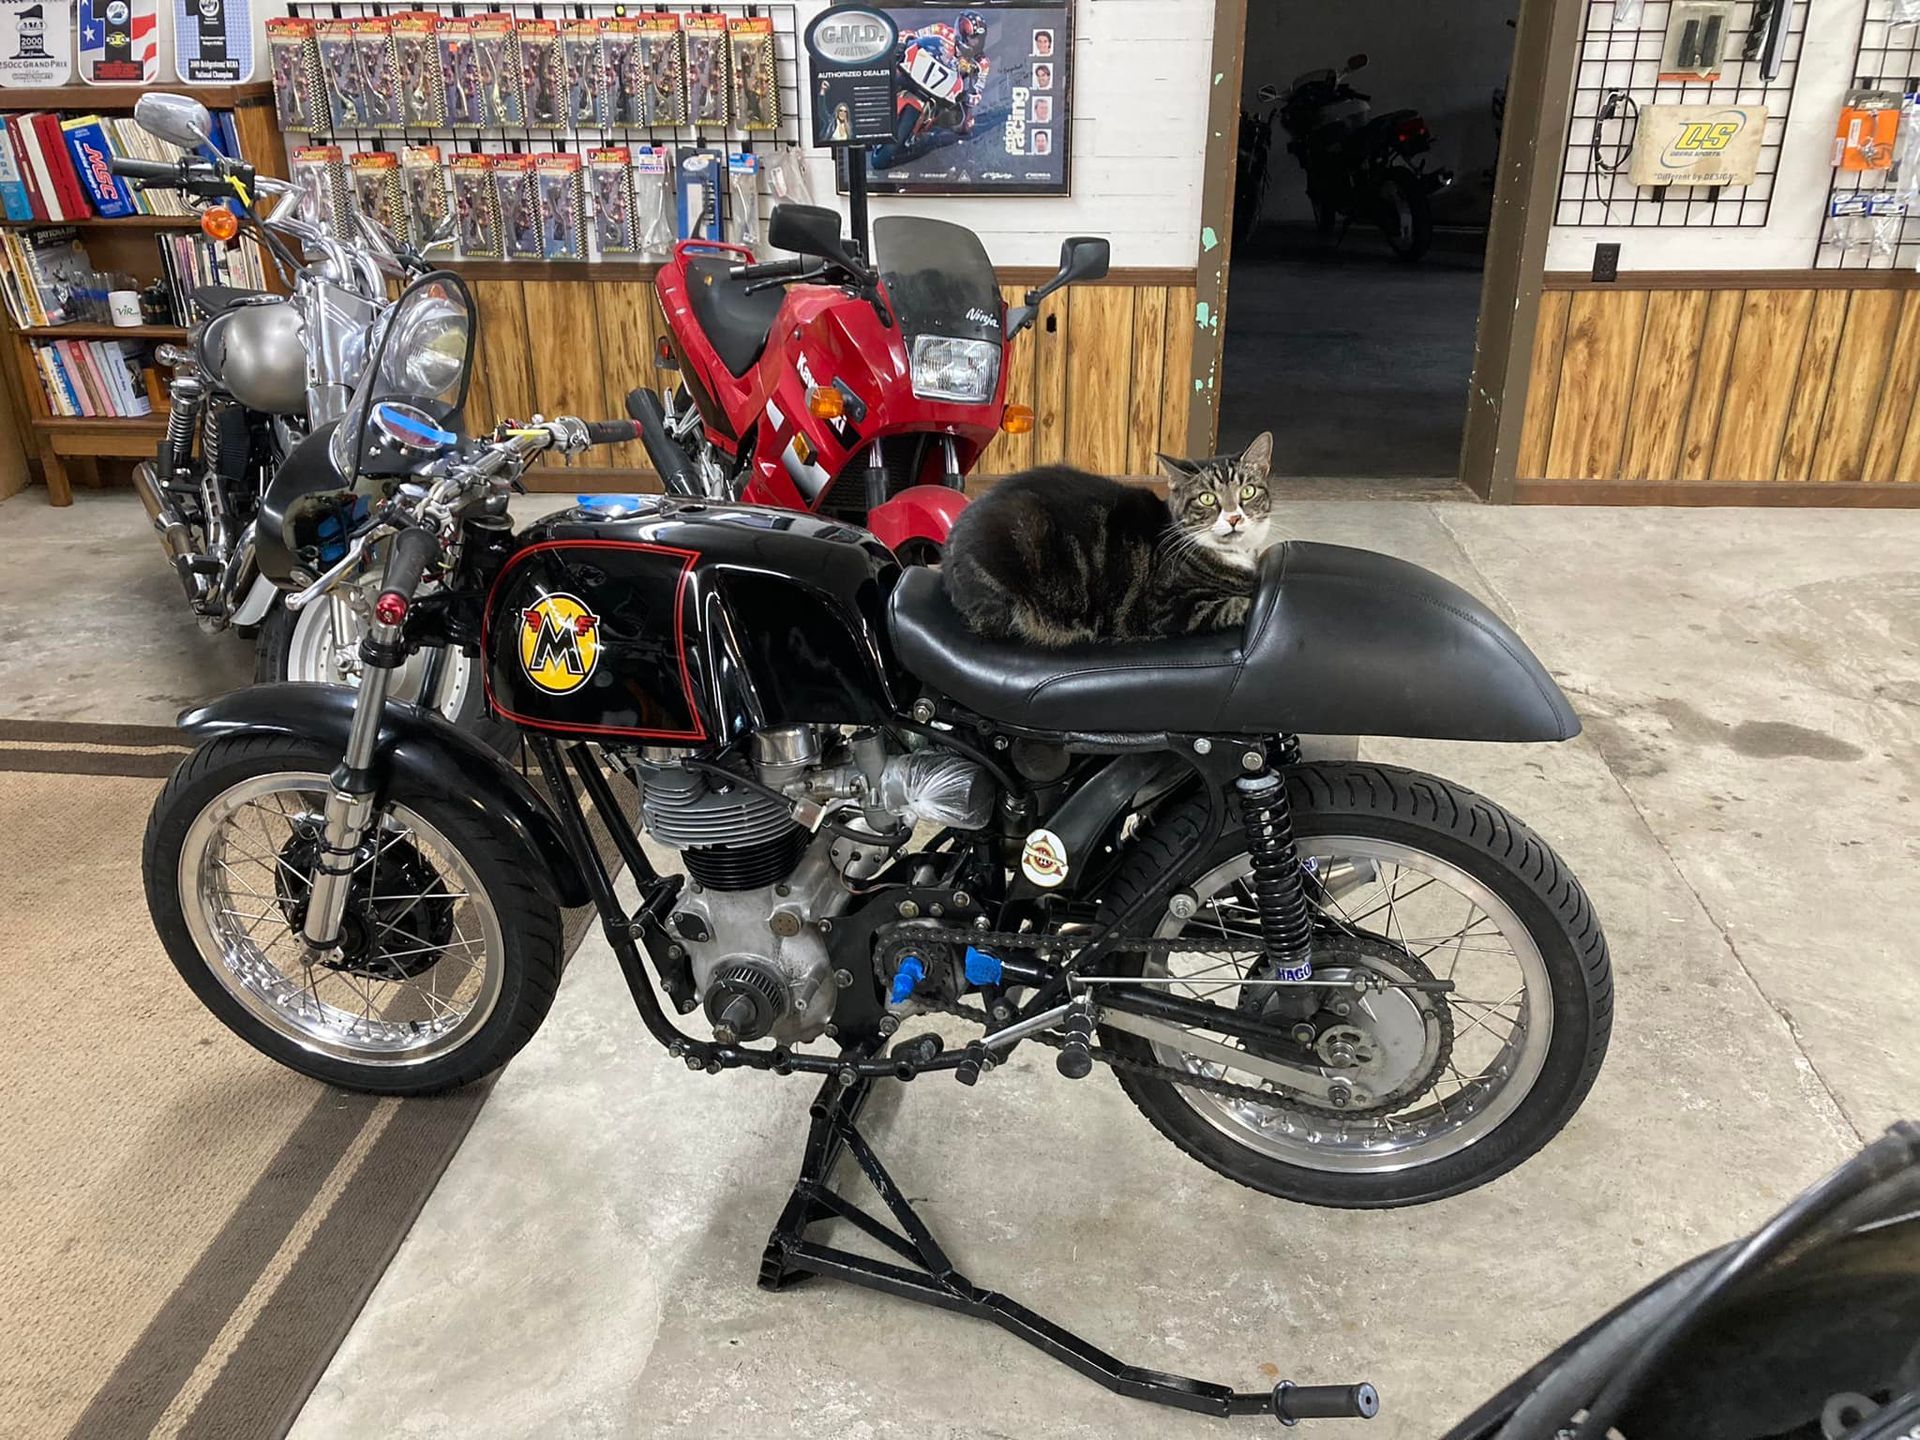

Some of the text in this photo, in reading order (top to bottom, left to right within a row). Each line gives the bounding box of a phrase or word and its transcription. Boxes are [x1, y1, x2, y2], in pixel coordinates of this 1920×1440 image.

[822, 24, 884, 43] G.M.D.
[818, 69, 890, 79] AUTHORIZED DEALER
[923, 61, 949, 90] 17
[1008, 86, 1030, 156] racing
[1675, 122, 1739, 150] DS
[83, 142, 118, 200] MSC
[1692, 173, 1701, 181] by
[966, 307, 999, 328] Ninja
[529, 611, 586, 676] M
